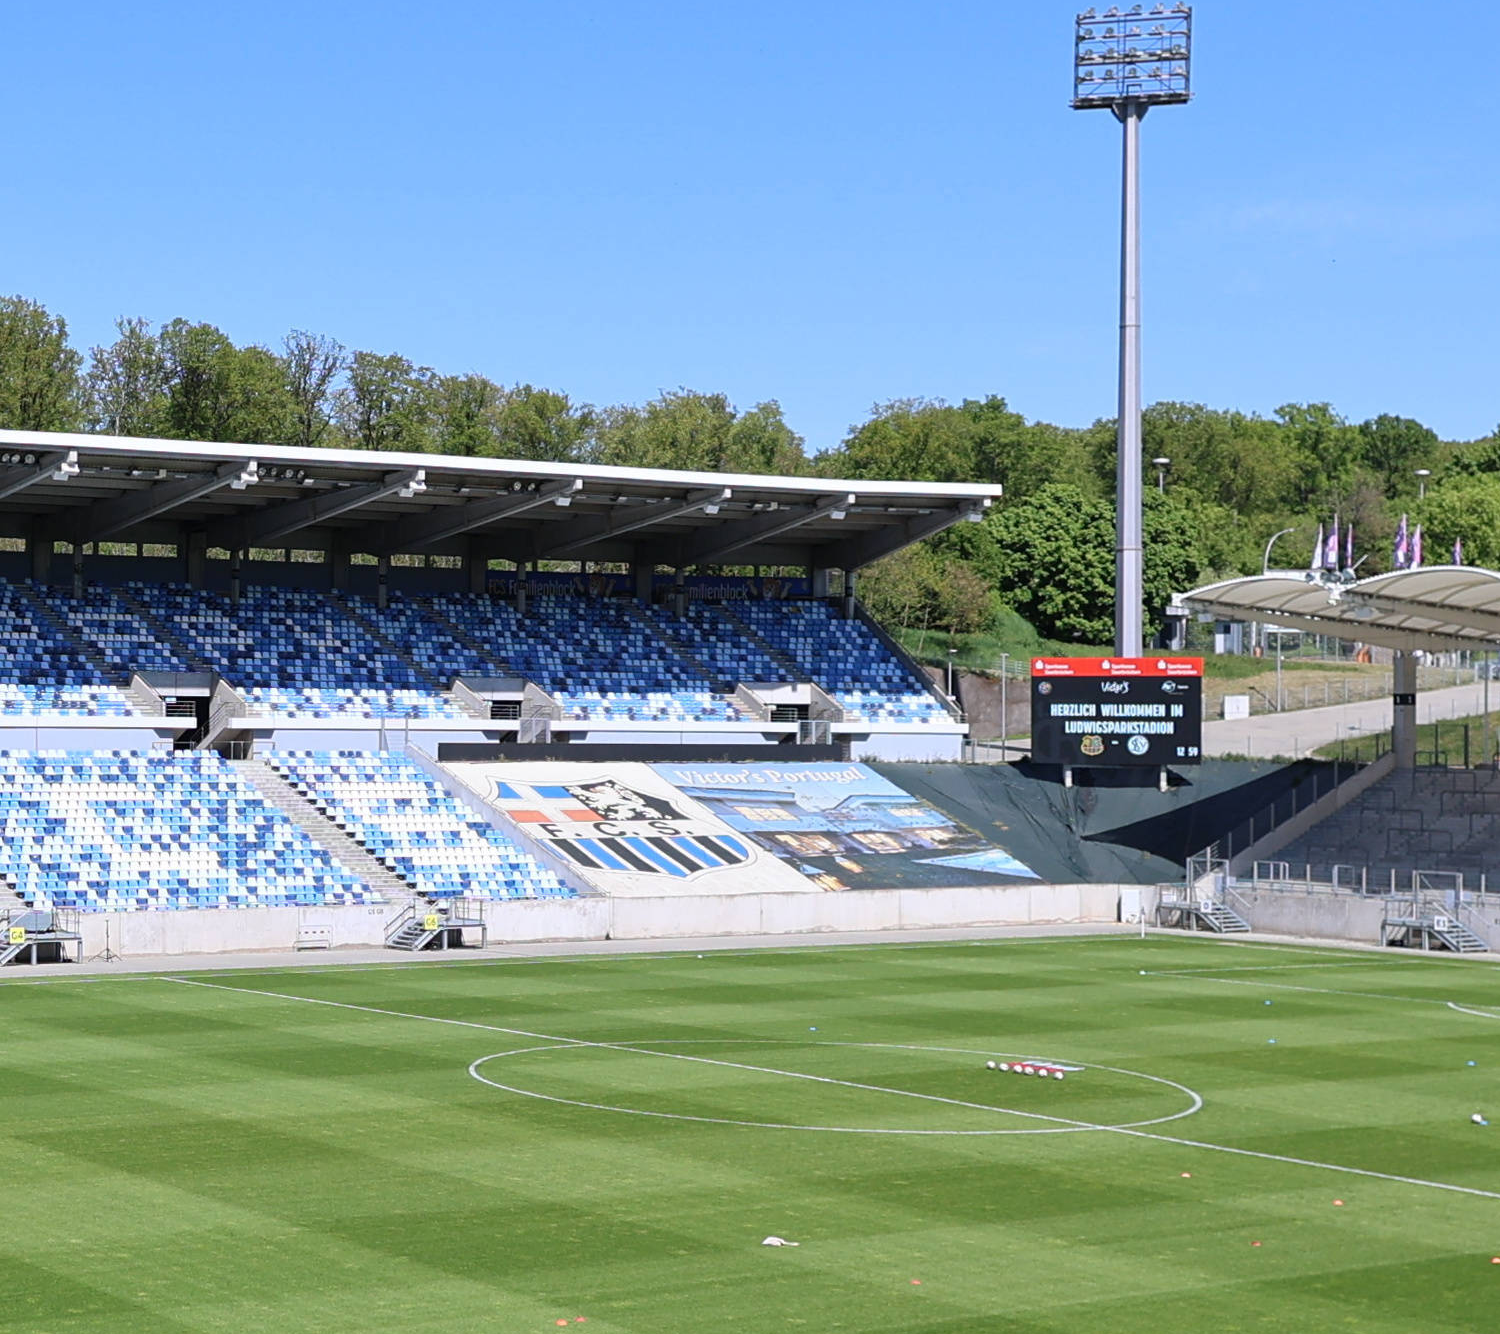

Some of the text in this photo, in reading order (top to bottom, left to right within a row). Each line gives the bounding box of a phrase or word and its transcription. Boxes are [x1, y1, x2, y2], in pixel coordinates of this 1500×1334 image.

[1050, 703, 1184, 717] HERZLICH WILLKOMMEN IM
[1064, 721, 1174, 734] LUDWIGSPARKSTADION
[673, 767, 867, 786] Victor's Portugal
[11, 930, 24, 941] G4
